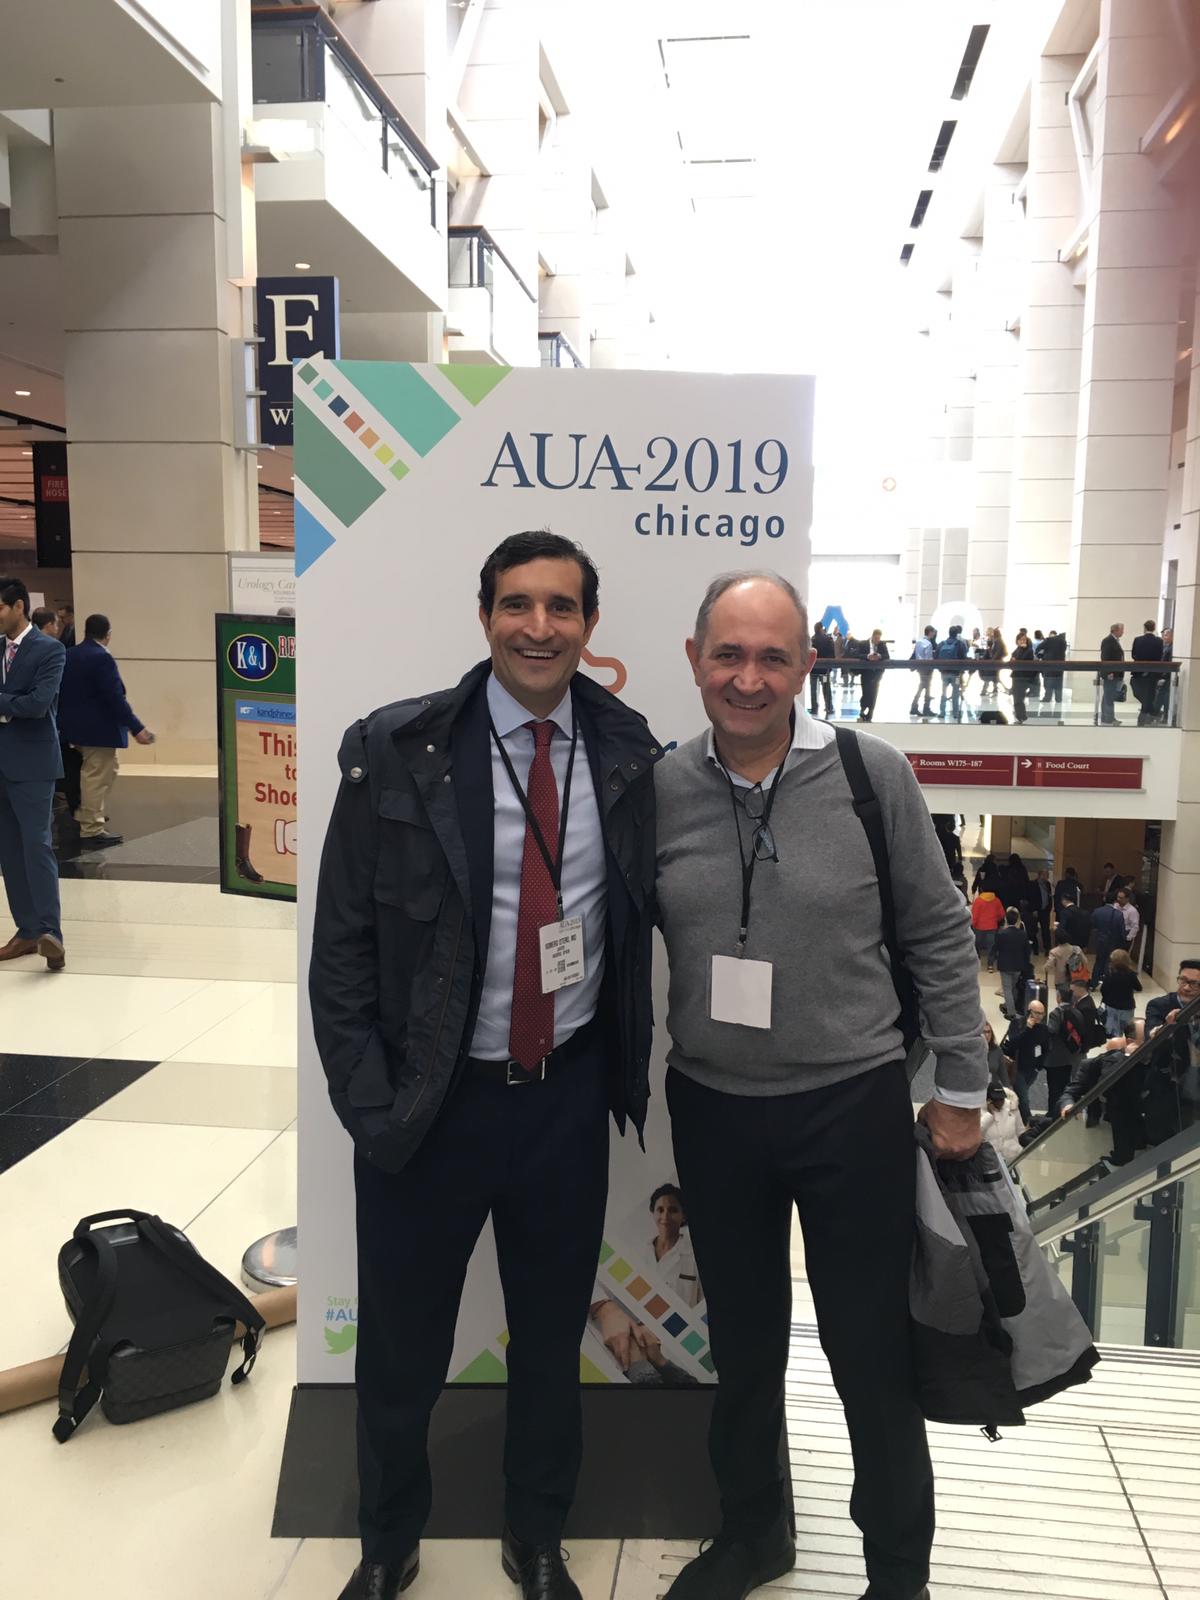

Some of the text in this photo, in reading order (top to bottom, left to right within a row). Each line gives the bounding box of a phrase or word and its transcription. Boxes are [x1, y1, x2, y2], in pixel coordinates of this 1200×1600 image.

[269, 408, 293, 426] W
[47, 480, 65, 489] FIRE
[46, 488, 67, 497] HOSE
[634, 503, 786, 547] chicago
[238, 577, 273, 592] Urology
[236, 641, 268, 671] K&J
[259, 731, 296, 757] Thi
[919, 759, 946, 767] Rooms
[1045, 761, 1090, 769] Food Court
[327, 1296, 351, 1308] Stay
